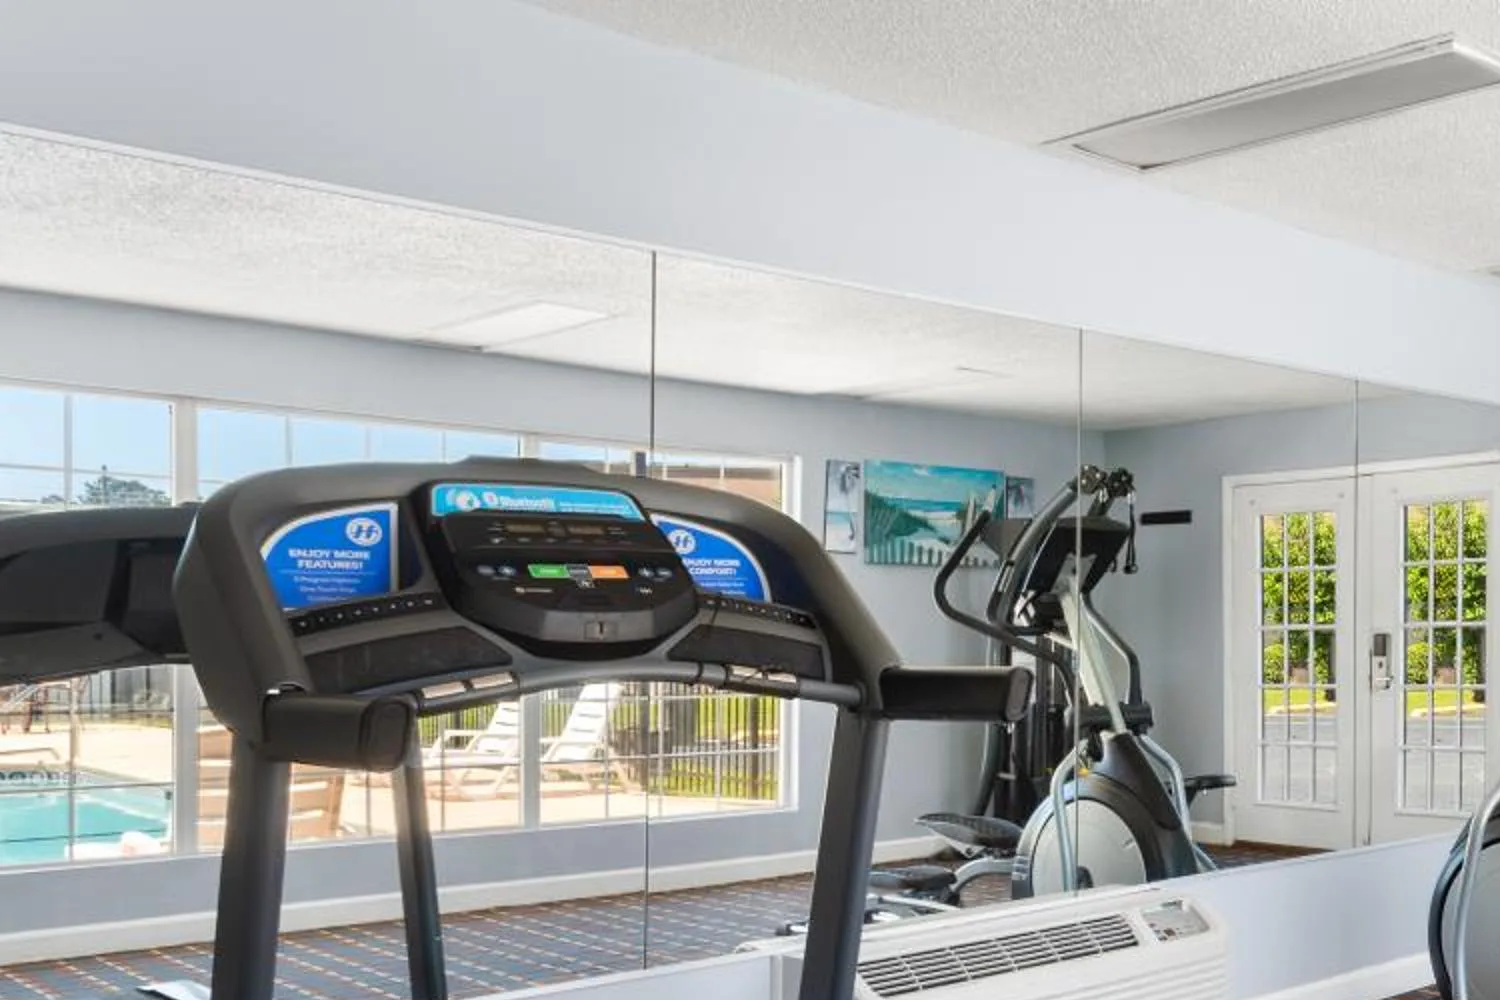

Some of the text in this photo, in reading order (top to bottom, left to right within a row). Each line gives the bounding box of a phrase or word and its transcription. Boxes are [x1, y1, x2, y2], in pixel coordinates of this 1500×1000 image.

[288, 548, 371, 560] ENJOY MORE
[297, 559, 363, 569] FEATURES!
